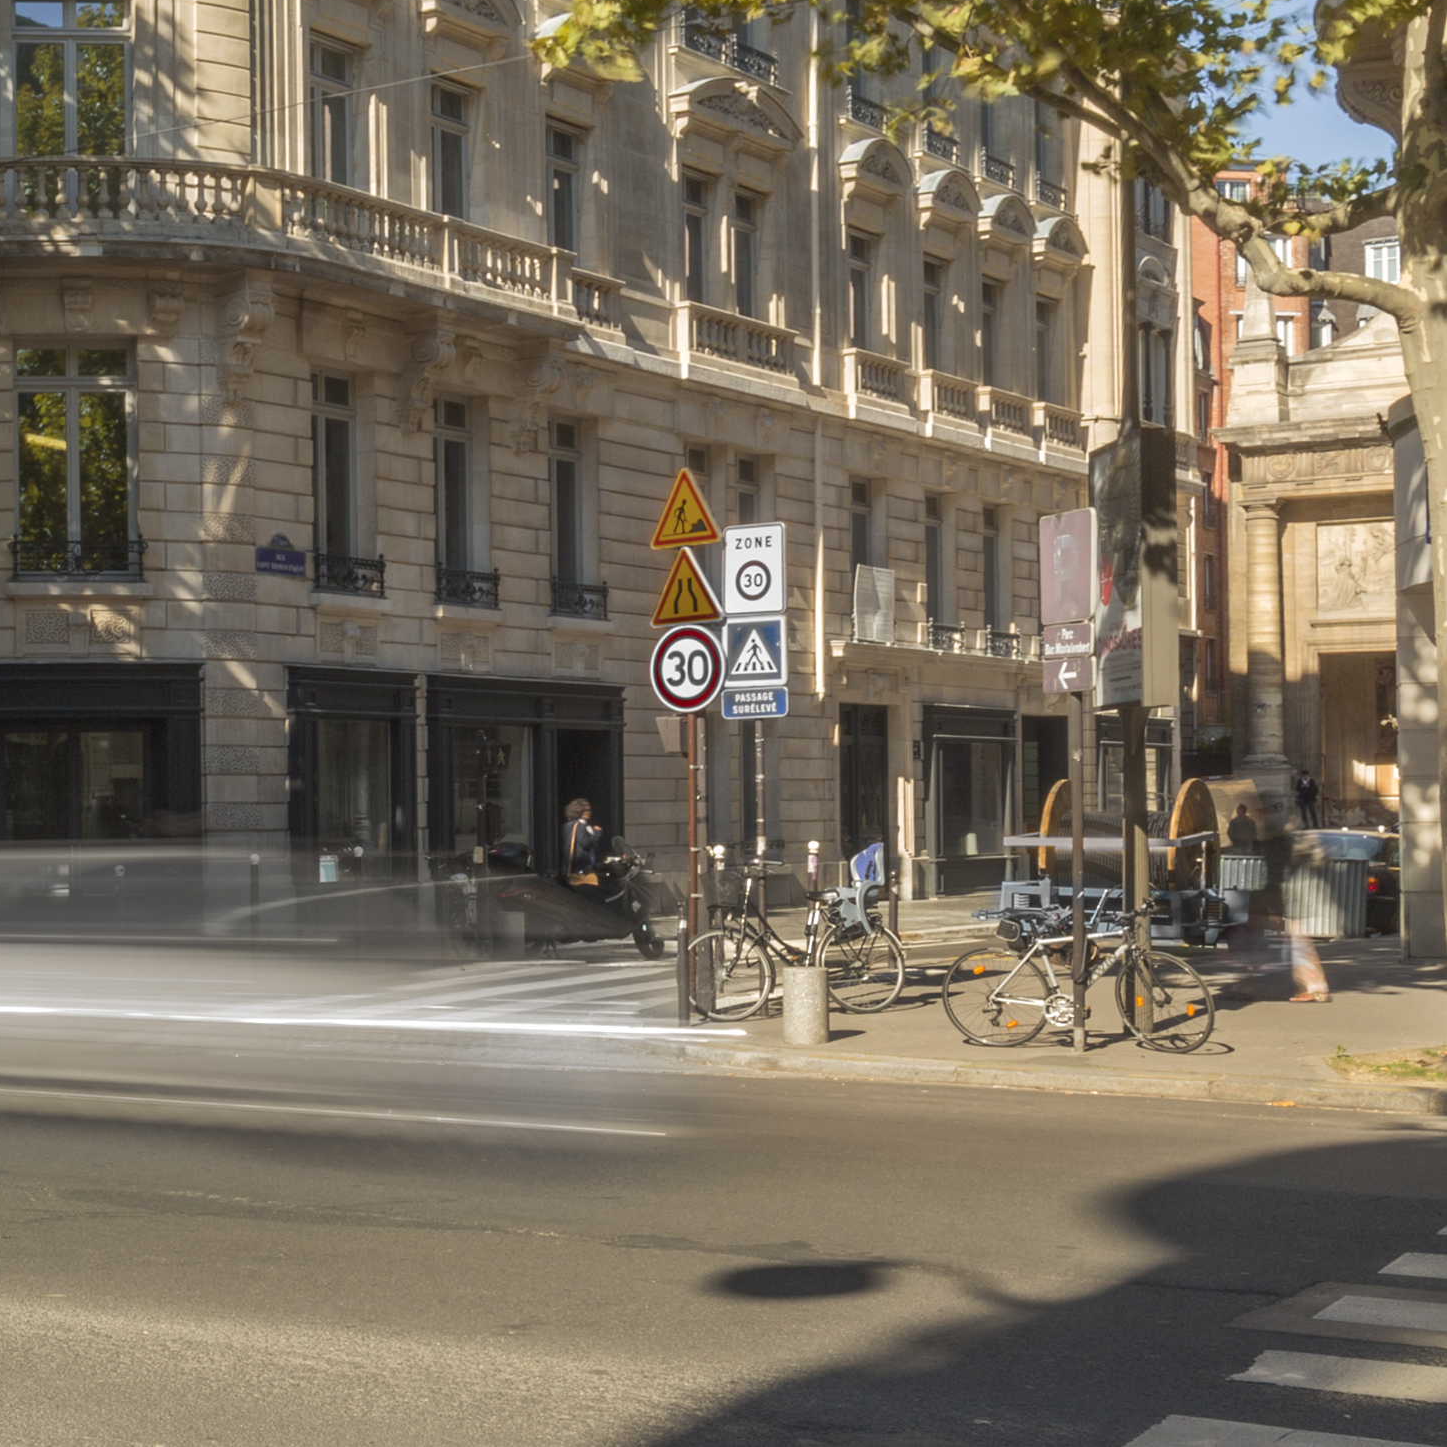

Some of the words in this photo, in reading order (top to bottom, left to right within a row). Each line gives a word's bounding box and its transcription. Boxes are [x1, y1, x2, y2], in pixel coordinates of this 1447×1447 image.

[735, 536, 772, 550] ZONE
[744, 573, 763, 587] 30
[1061, 628, 1073, 640] Parc
[666, 649, 709, 687] 30
[735, 692, 774, 702] PASSAGE
[732, 702, 777, 714] SURÉLEVÉ
